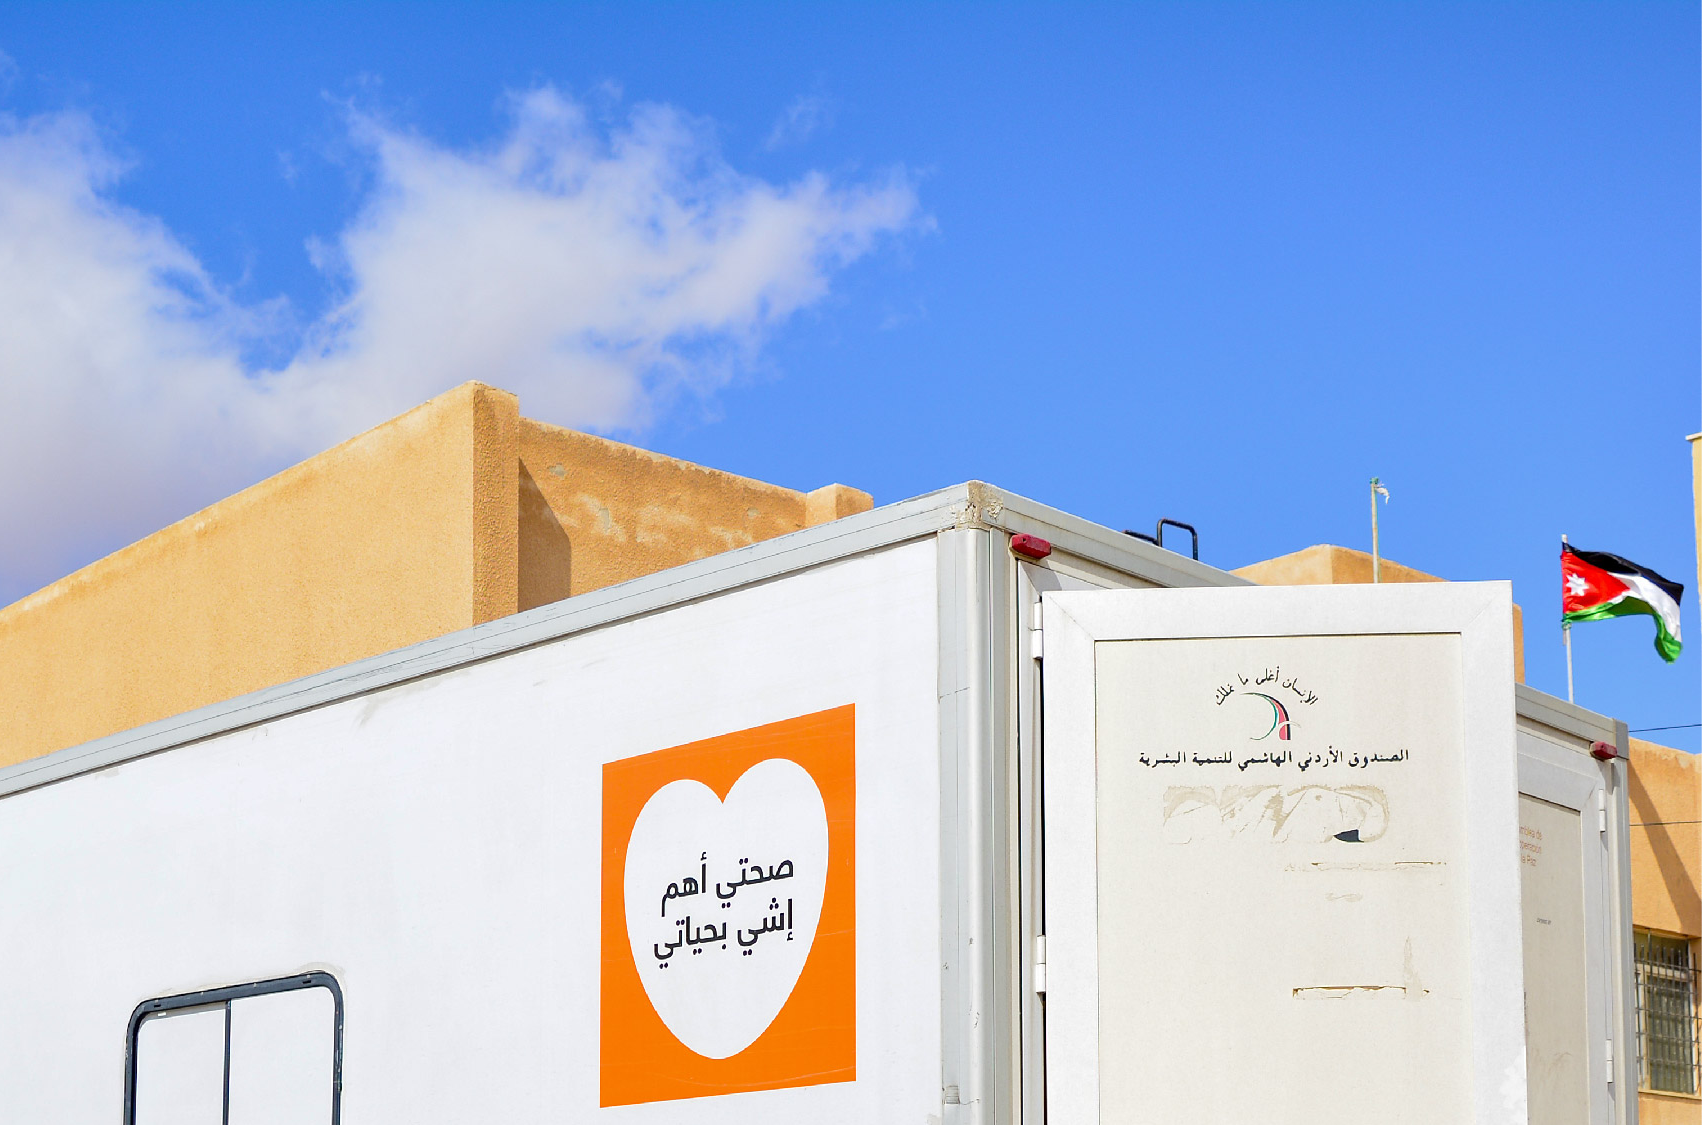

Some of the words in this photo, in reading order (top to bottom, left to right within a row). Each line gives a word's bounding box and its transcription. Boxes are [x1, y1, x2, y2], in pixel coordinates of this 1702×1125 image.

[1138, 750, 1187, 769] البشرية
[1191, 750, 1233, 768] للتنمية
[1237, 750, 1293, 772] الهاشمي
[1297, 745, 1344, 772] الأردني
[1348, 748, 1410, 769] الصندوق
[661, 851, 707, 918] أهم
[715, 857, 794, 909] صحتي
[737, 897, 794, 957] إشي
[653, 915, 727, 970] بحياتي
